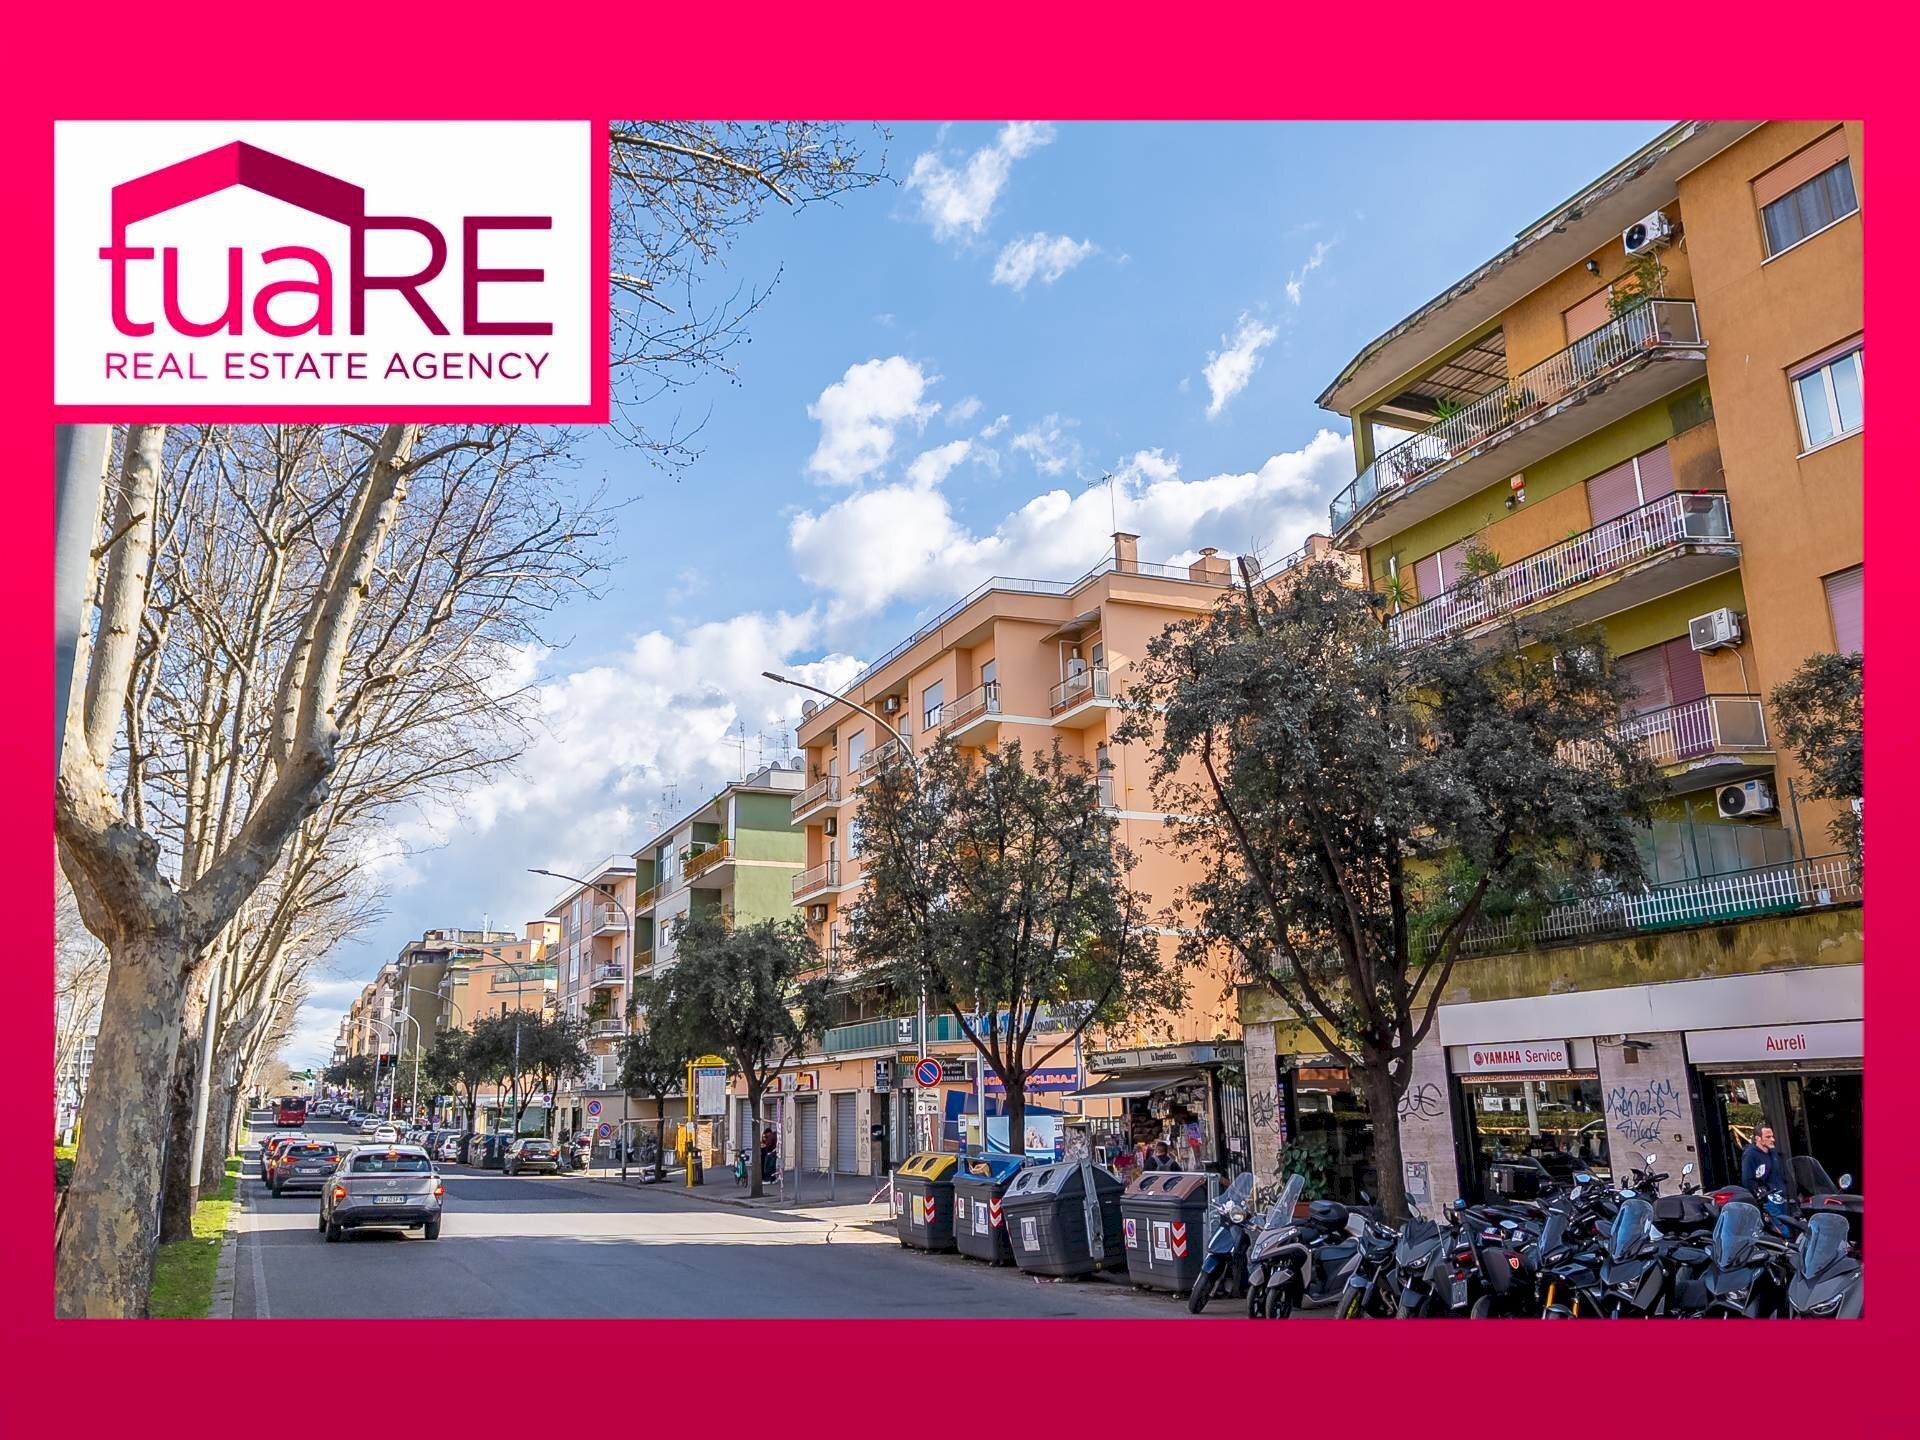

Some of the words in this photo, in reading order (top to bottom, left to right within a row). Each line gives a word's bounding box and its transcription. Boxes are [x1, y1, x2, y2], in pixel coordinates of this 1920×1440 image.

[1766, 1034, 1806, 1051] Aureli
[1484, 1051, 1521, 1064] YAMAHA
[1525, 1050, 1562, 1063] Service
